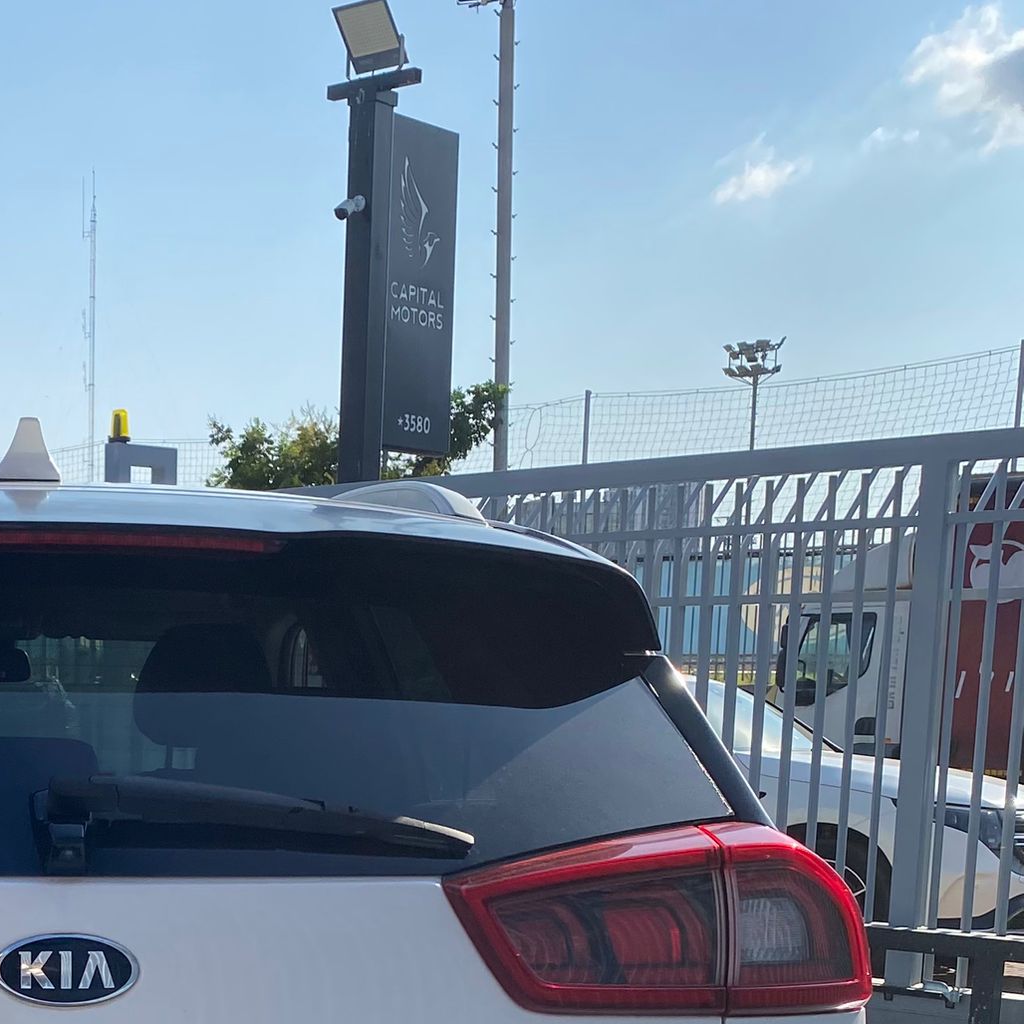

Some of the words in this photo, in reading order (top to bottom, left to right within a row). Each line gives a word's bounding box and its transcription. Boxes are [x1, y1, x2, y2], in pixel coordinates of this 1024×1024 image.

[390, 281, 444, 309] CAPITAL
[390, 304, 444, 330] MOTORS
[18, 950, 116, 990] KIA
